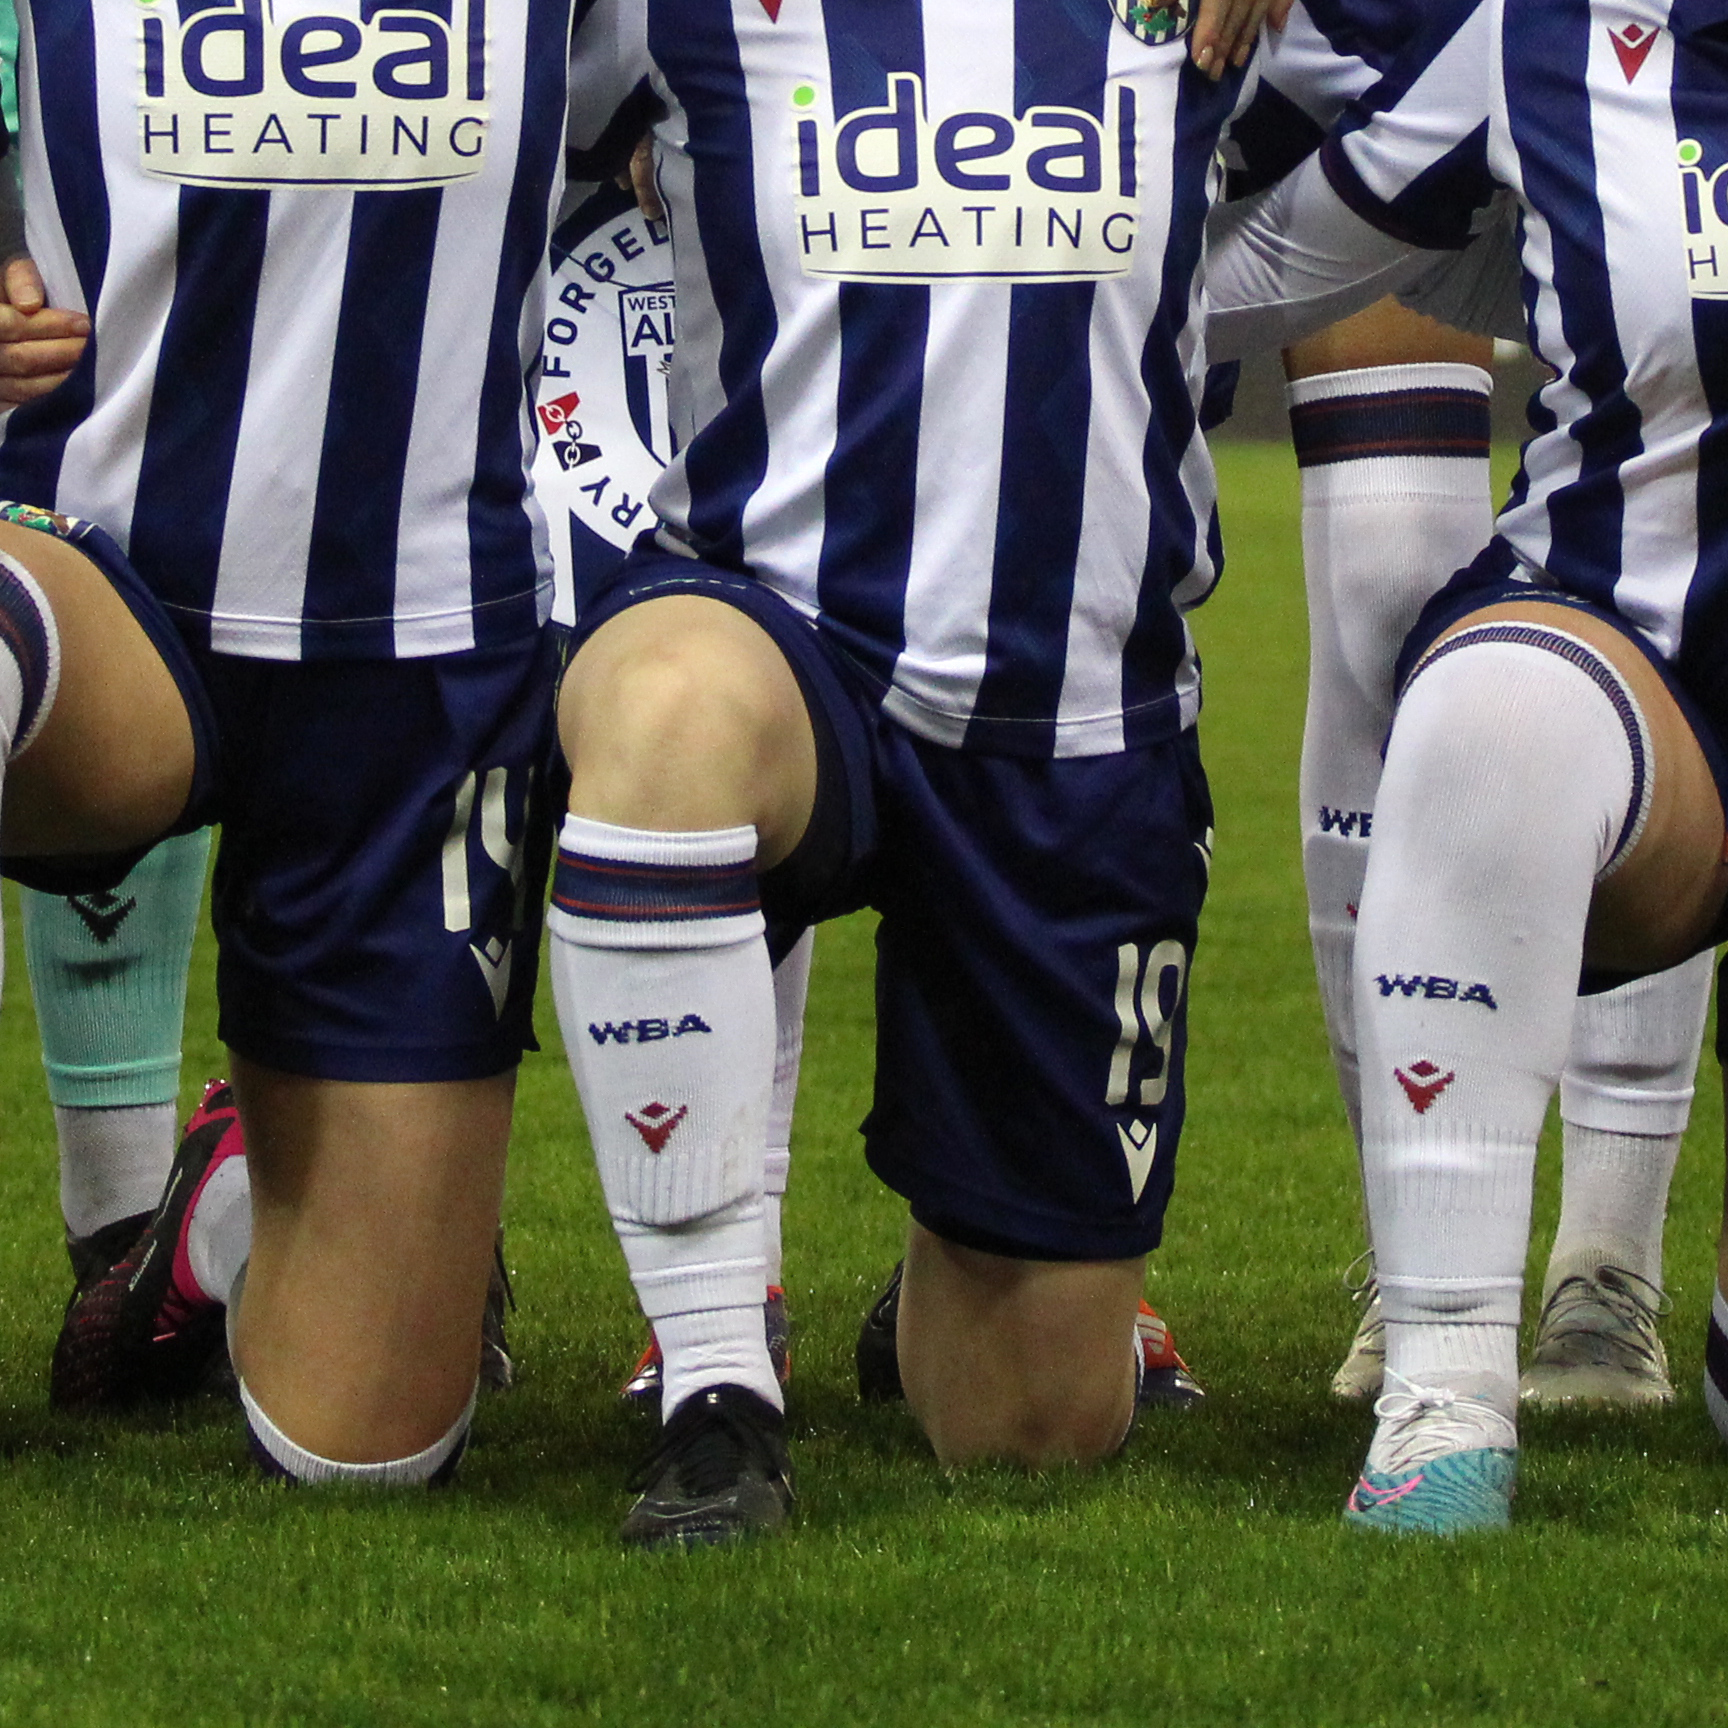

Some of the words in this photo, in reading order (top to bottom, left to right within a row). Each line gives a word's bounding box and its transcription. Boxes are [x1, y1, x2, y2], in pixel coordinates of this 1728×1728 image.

[144, 113, 485, 158] HEATING
[791, 77, 1137, 199] ideal
[801, 205, 1136, 255] HEATING
[628, 295, 676, 311] WEST
[1318, 805, 1374, 838] WB
[1373, 972, 1498, 1010] WBA
[588, 1012, 713, 1045] WBA
[1105, 939, 1187, 1105] 19
